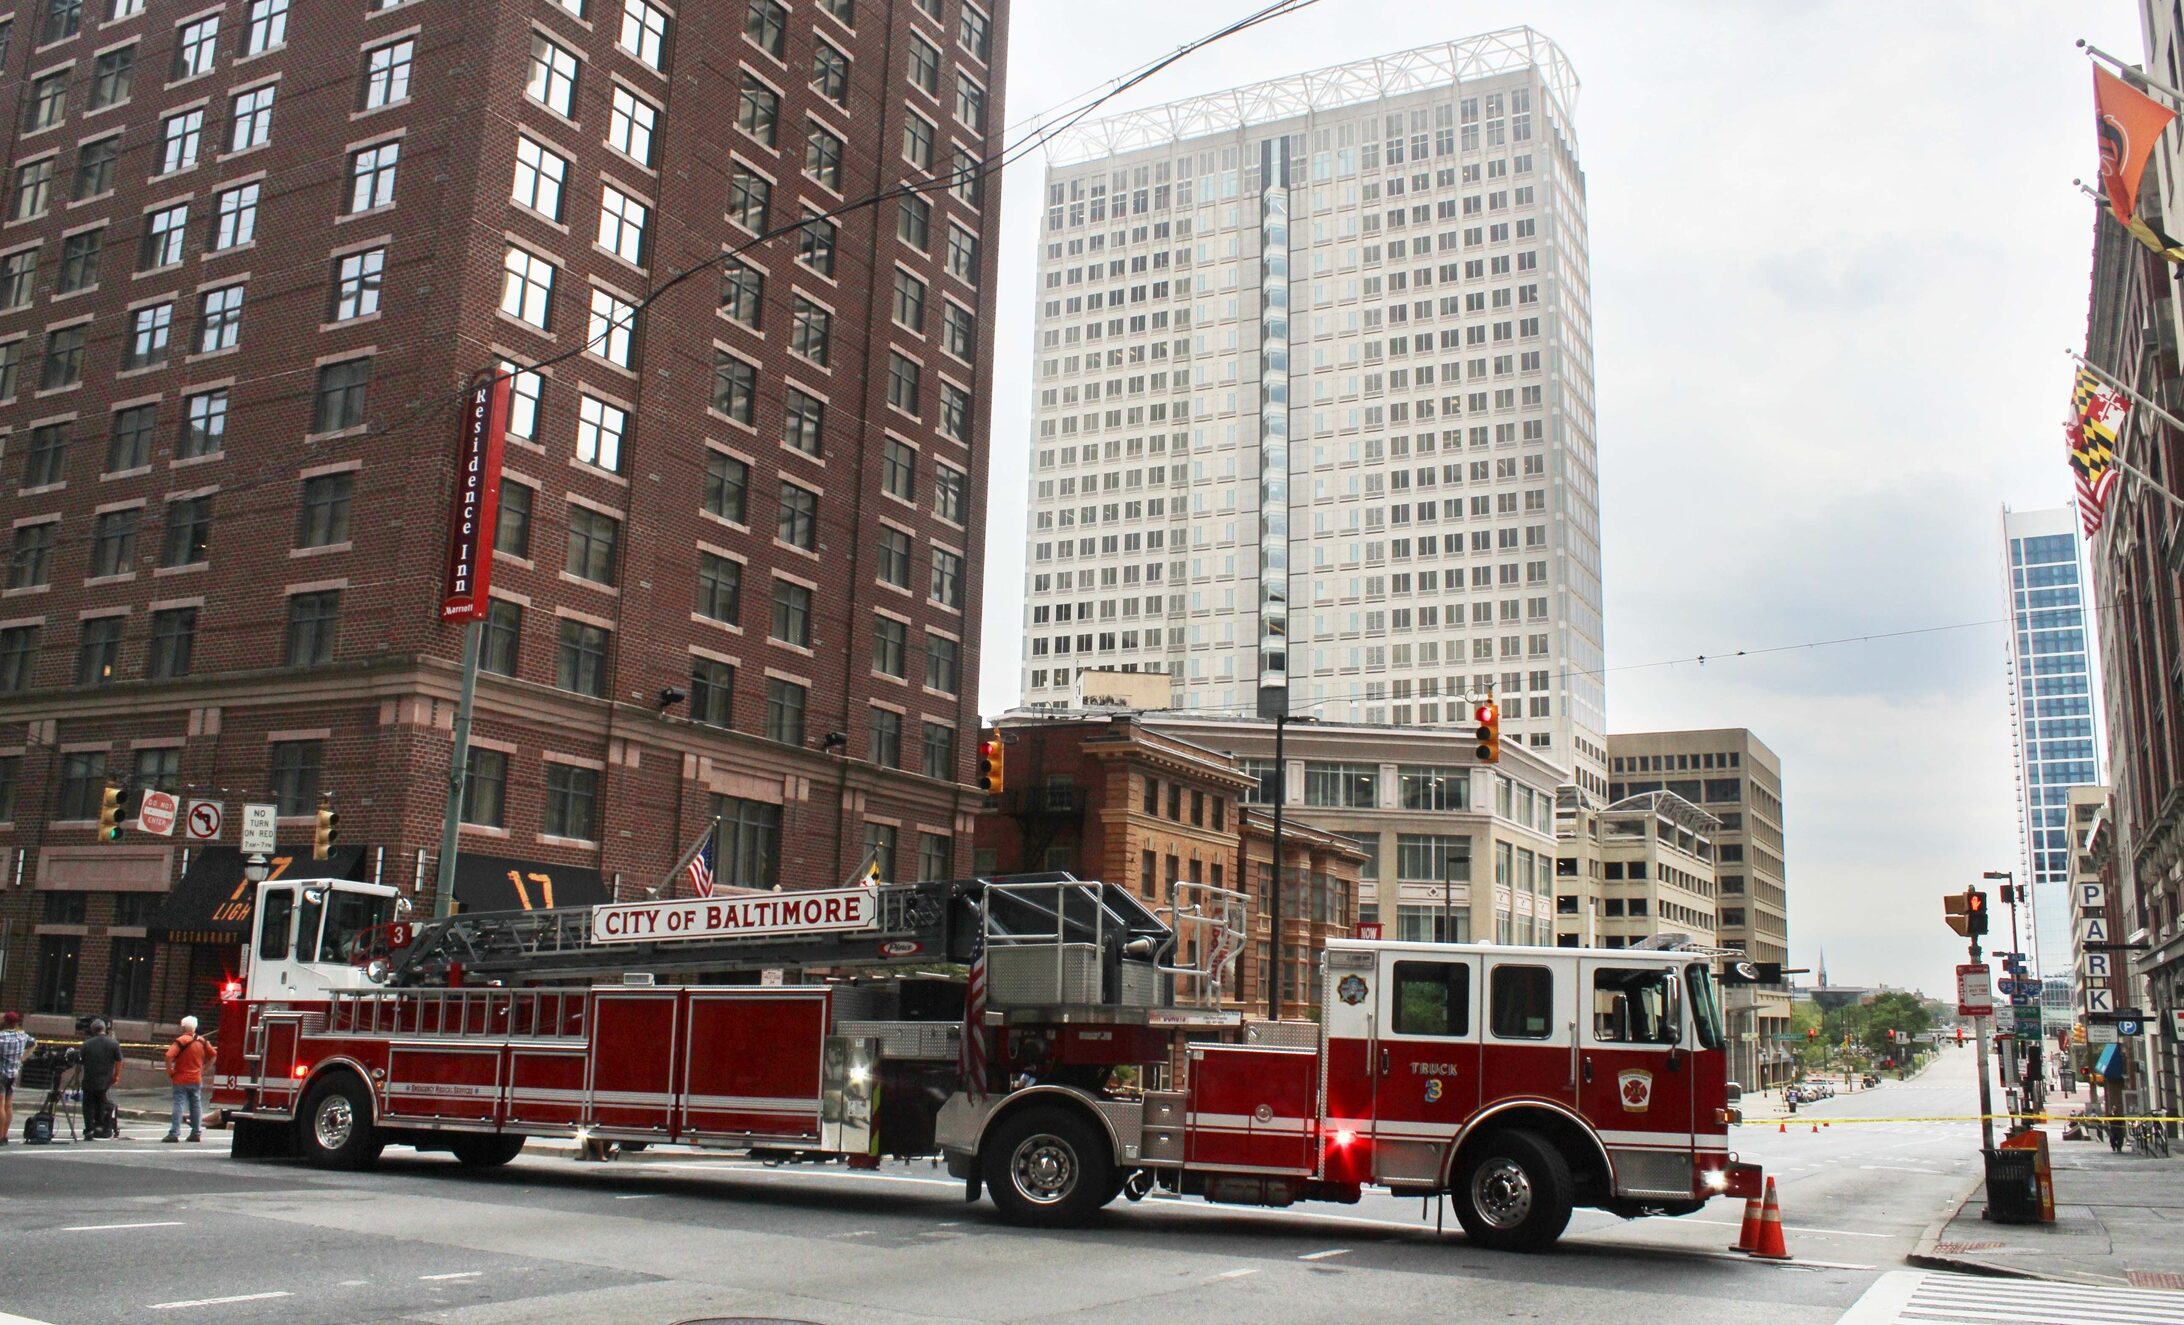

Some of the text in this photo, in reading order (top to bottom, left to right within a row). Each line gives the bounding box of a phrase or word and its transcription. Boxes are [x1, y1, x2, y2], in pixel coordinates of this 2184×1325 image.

[455, 389, 486, 592] Residence Inn
[444, 603, 474, 616] Marriott
[148, 799, 173, 811] DO NOT
[147, 816, 167, 828] ENTER
[250, 819, 269, 828] TURN
[245, 829, 274, 838] ON RED
[605, 896, 861, 935] CITY OF BALTIMORE
[168, 930, 238, 943] RESTAURANT
[393, 926, 404, 944] 3
[1360, 927, 1377, 940] NOW
[2084, 885, 2109, 1010] PARK
[2000, 983, 2013, 991] 95
[2023, 984, 2040, 992] 395
[1410, 1062, 1458, 1076] TRUCK
[228, 1075, 236, 1090] 3
[1425, 1079, 1443, 1103] 3
